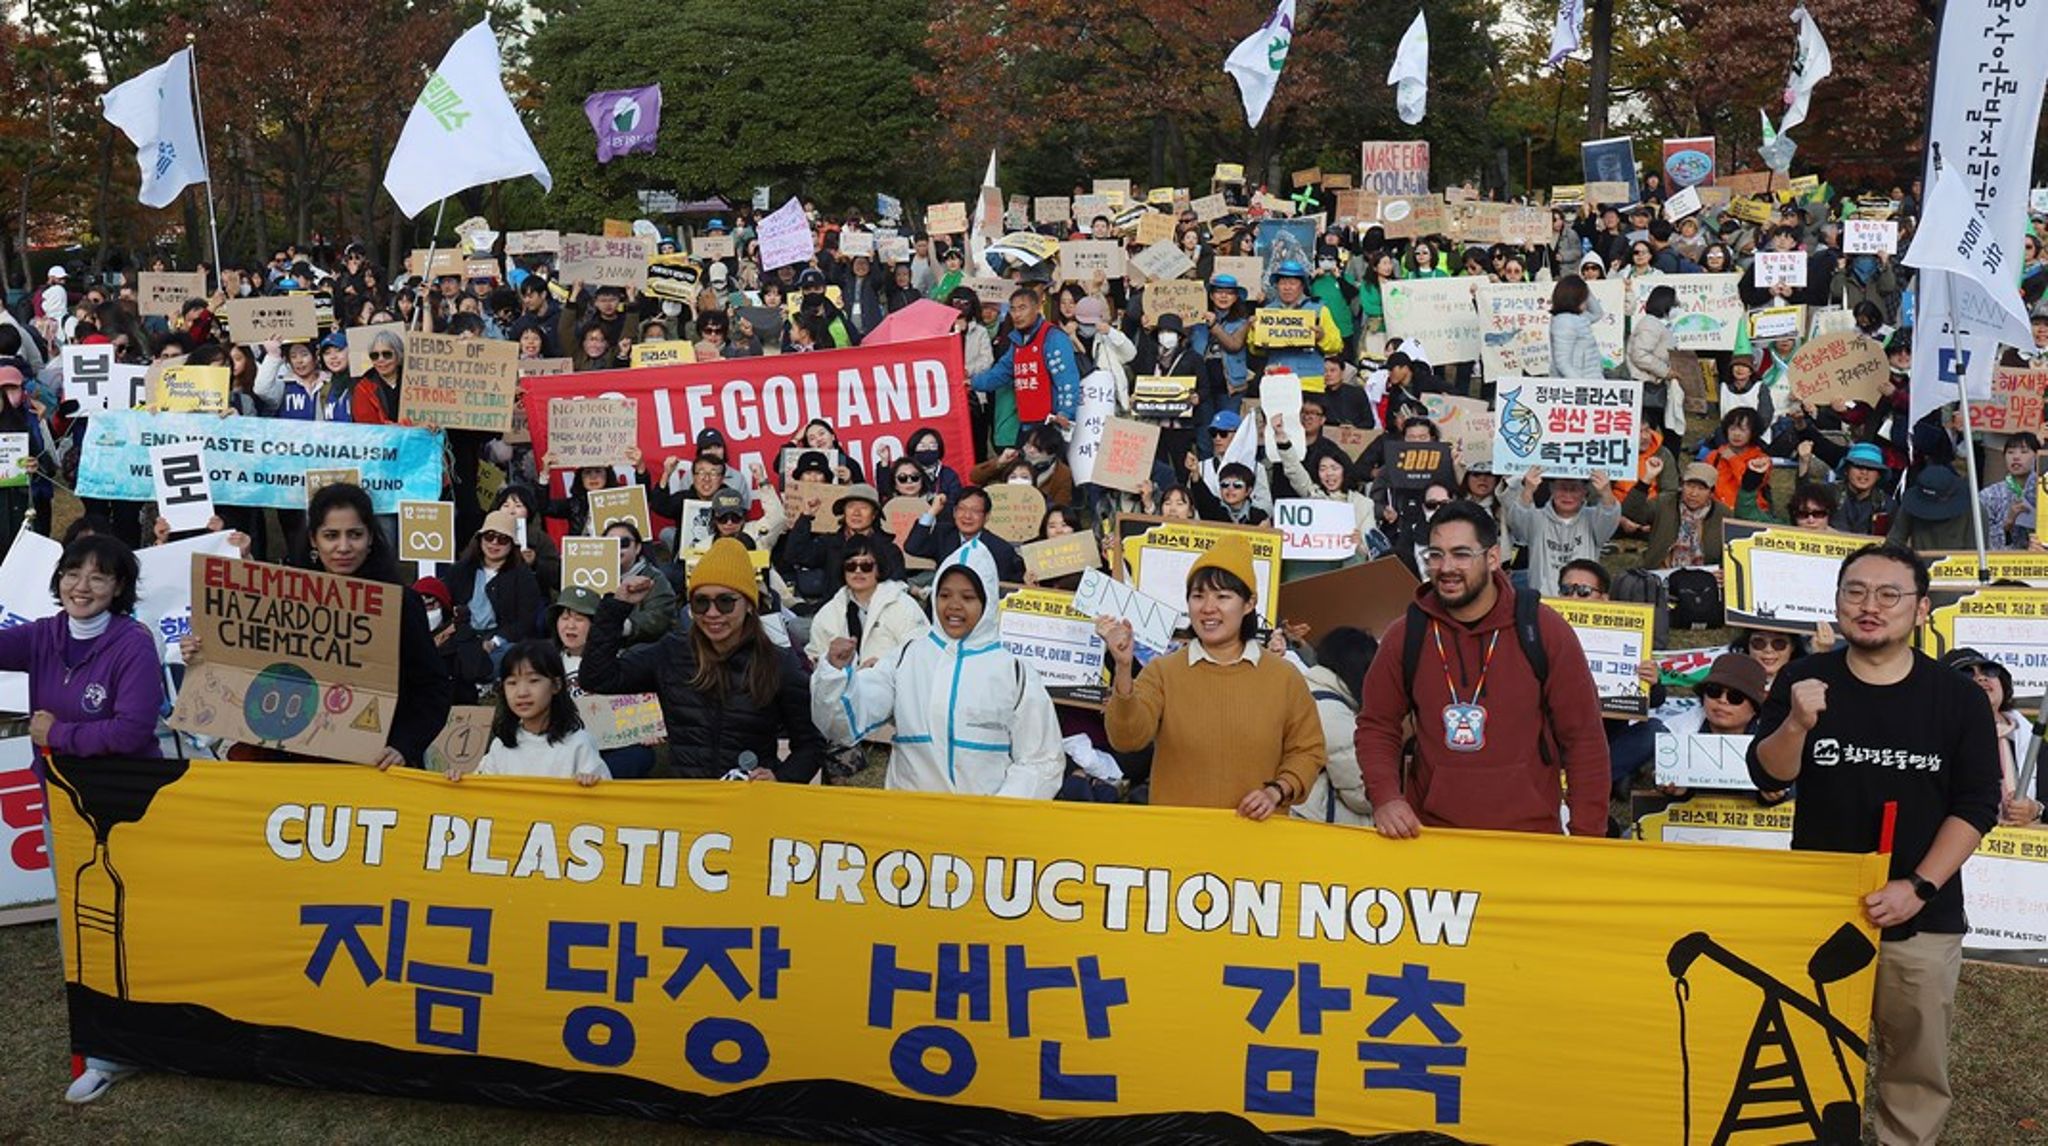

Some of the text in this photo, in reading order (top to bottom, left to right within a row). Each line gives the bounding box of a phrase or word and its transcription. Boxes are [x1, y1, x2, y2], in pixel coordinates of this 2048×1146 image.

[419, 72, 473, 133] 린피스
[1365, 145, 1400, 171] MAKE
[1365, 174, 1403, 195] COOL
[1261, 316, 1304, 327] NO MORE
[409, 337, 485, 359] HEADS OF
[71, 354, 109, 396] 부
[405, 375, 428, 386] WE
[492, 381, 501, 392] A
[404, 387, 457, 404] STRONG
[653, 358, 951, 447] LEGOLAND
[552, 402, 617, 415] NO MORE
[464, 413, 509, 428] TREATY
[1547, 407, 1632, 436] 생산 감축
[141, 431, 398, 463] END ASTE COLONIALISM
[1540, 439, 1632, 467] 촉구한다
[130, 464, 404, 492] WE OT A DUMPI OUND
[161, 453, 208, 506] 로
[1279, 506, 1313, 528] NO
[1147, 533, 1191, 549] 플라스틱
[1281, 531, 1353, 551] PLASTIC
[1754, 536, 1795, 551] 플라스틱
[1798, 542, 1820, 555] 저감
[1933, 566, 1974, 578] 플라스틱
[204, 557, 384, 617] ELIMINATE
[1007, 597, 1042, 611] 플라스틱
[1959, 603, 2008, 616] 플라스틱
[2011, 603, 2036, 617] 저감
[205, 587, 373, 647] HAZARDOUS
[1567, 612, 1590, 625] 저감
[218, 620, 363, 669] CHEMICAL
[1623, 643, 1637, 657] 는
[1669, 808, 1719, 826] 플라스틱
[1722, 812, 1749, 827] 저감
[1988, 839, 2016, 856] 저감
[265, 804, 1481, 948] CUT PLASTIC PRODUCTION NOW
[1975, 929, 2001, 939] MORE
[2004, 931, 2047, 943] PLASTIC!
[300, 898, 494, 1054] 지금
[545, 920, 791, 1083] 당장
[1222, 961, 1468, 1125] 감축
